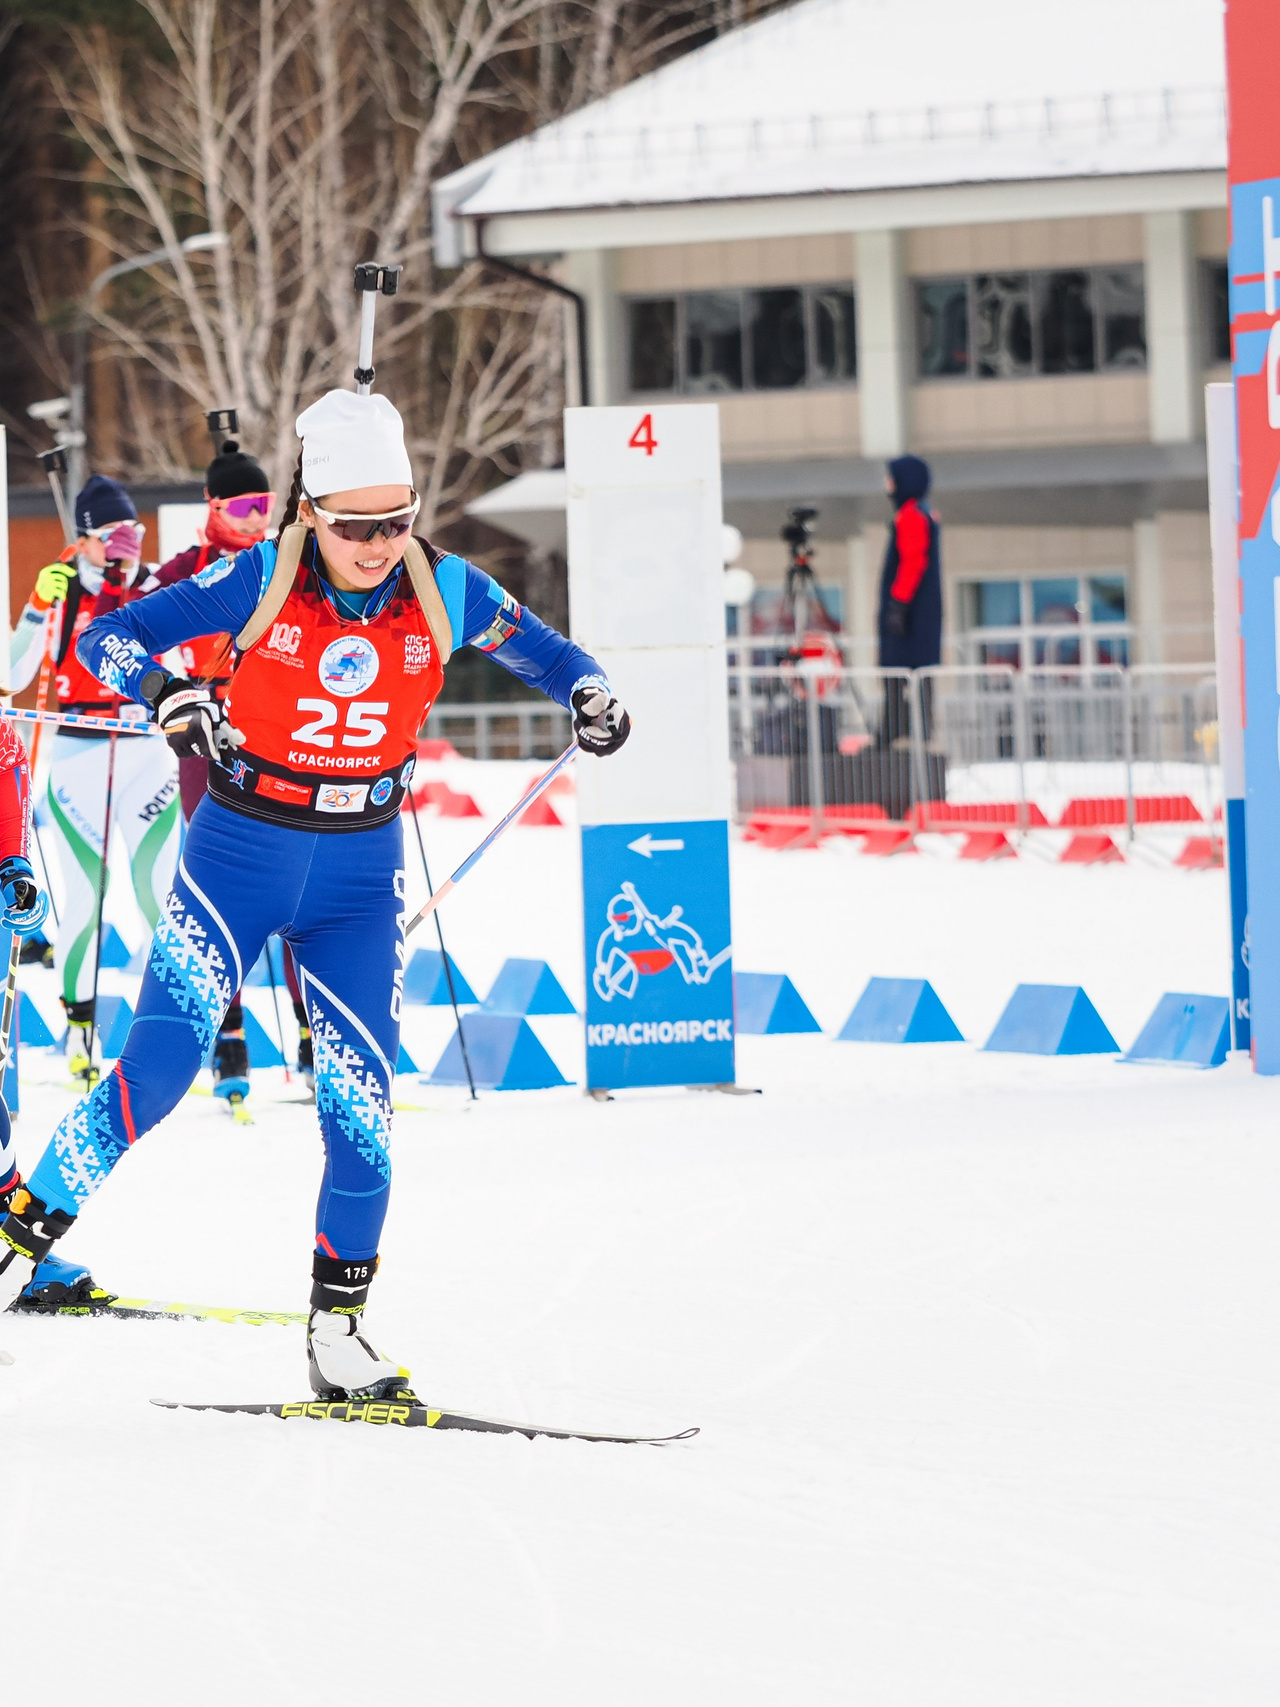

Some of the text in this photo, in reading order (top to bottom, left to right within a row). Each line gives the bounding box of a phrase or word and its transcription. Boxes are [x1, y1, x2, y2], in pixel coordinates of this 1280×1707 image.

[629, 413, 658, 456] 4
[100, 634, 143, 677] ЯМАЛ
[290, 698, 390, 748] 25
[287, 751, 382, 769] КРАСНОЯРСК
[587, 1018, 733, 1047] КРАСНОЯРСК
[344, 1266, 368, 1280] 175
[58, 1306, 91, 1315] FISCHER
[280, 1402, 411, 1425] FISCHER
